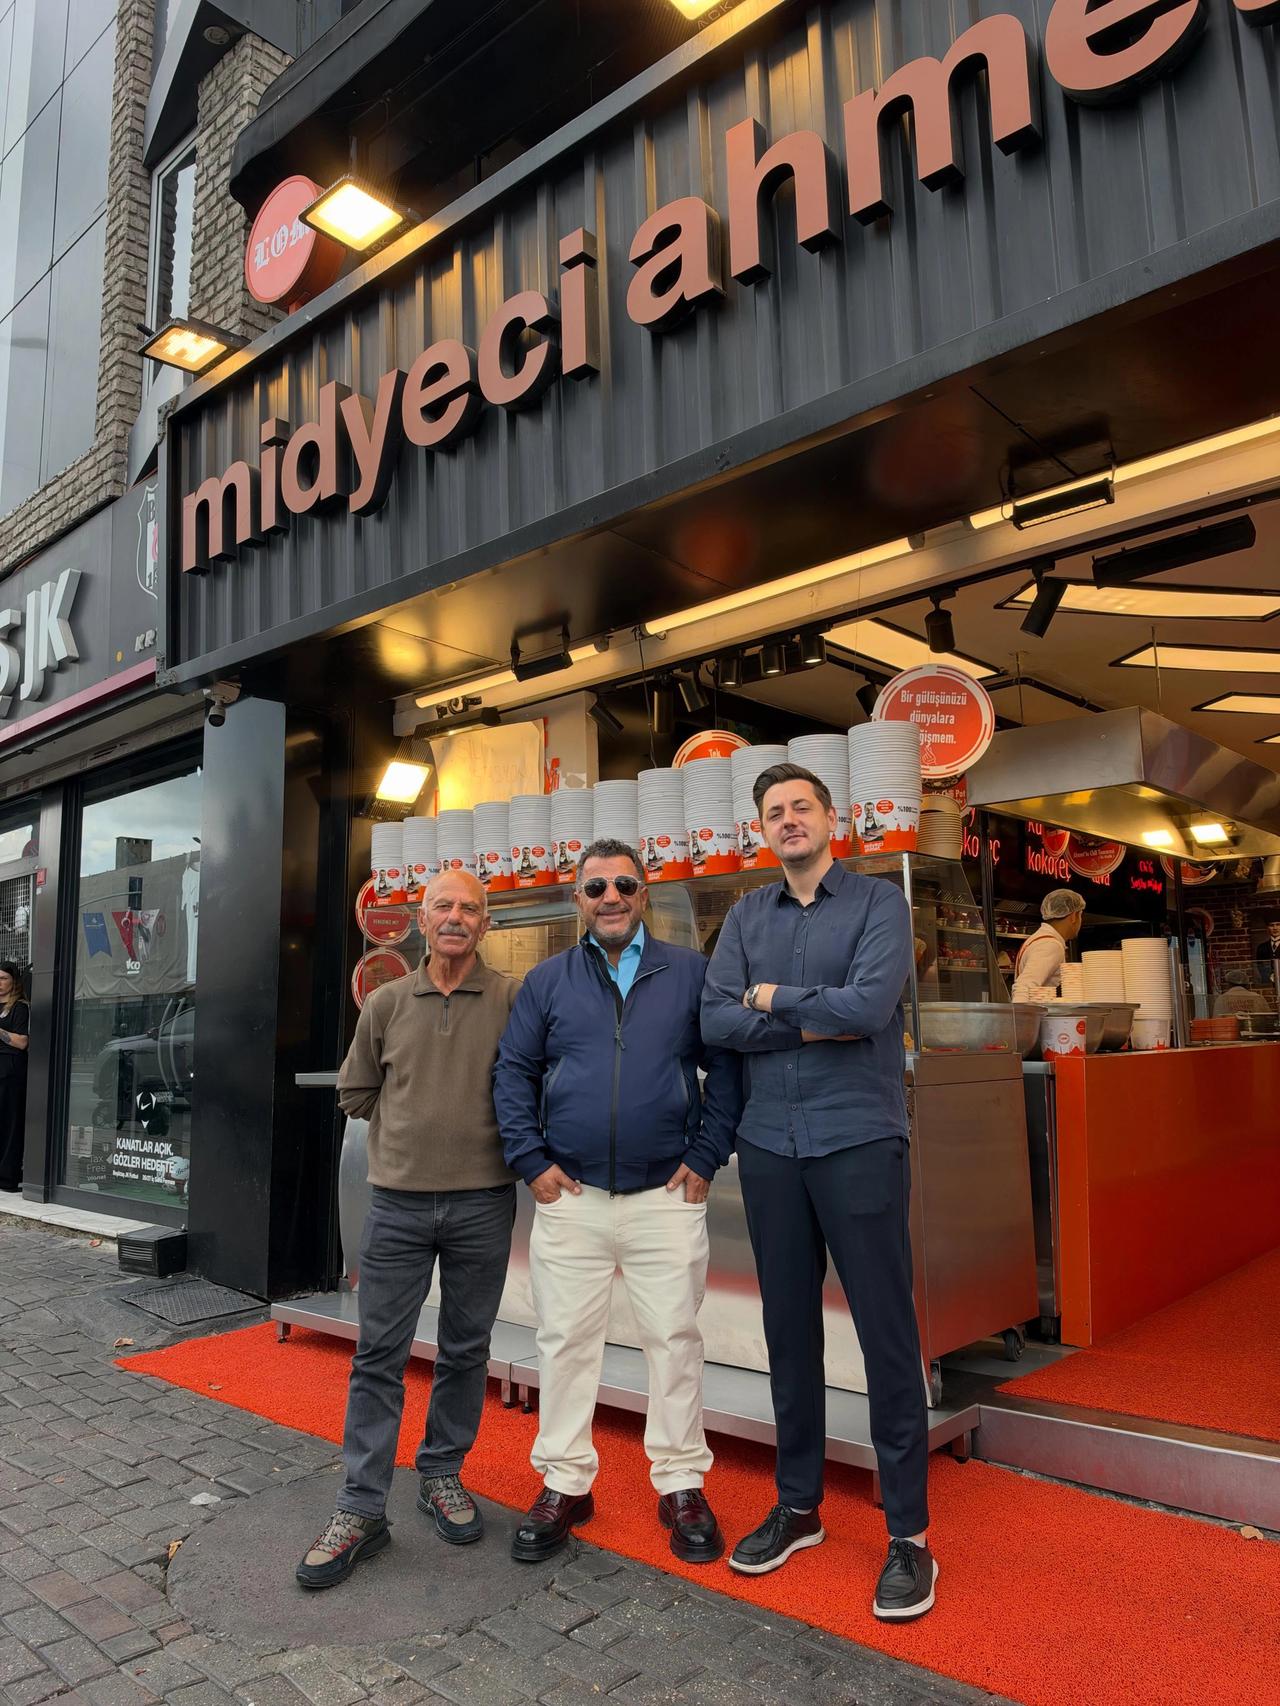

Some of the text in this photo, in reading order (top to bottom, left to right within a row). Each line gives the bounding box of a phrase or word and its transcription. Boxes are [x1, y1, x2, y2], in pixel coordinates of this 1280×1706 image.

[182, 0, 1280, 575] midyeci ahme
[901, 690, 967, 707] Bir gülüşünüzü
[910, 710, 955, 726] dünyalara
[920, 729, 957, 745] ğişmem.
[116, 1137, 153, 1153] KANATLAR
[154, 1142, 174, 1158] AÇIK.
[113, 1151, 141, 1168] GÖZLER
